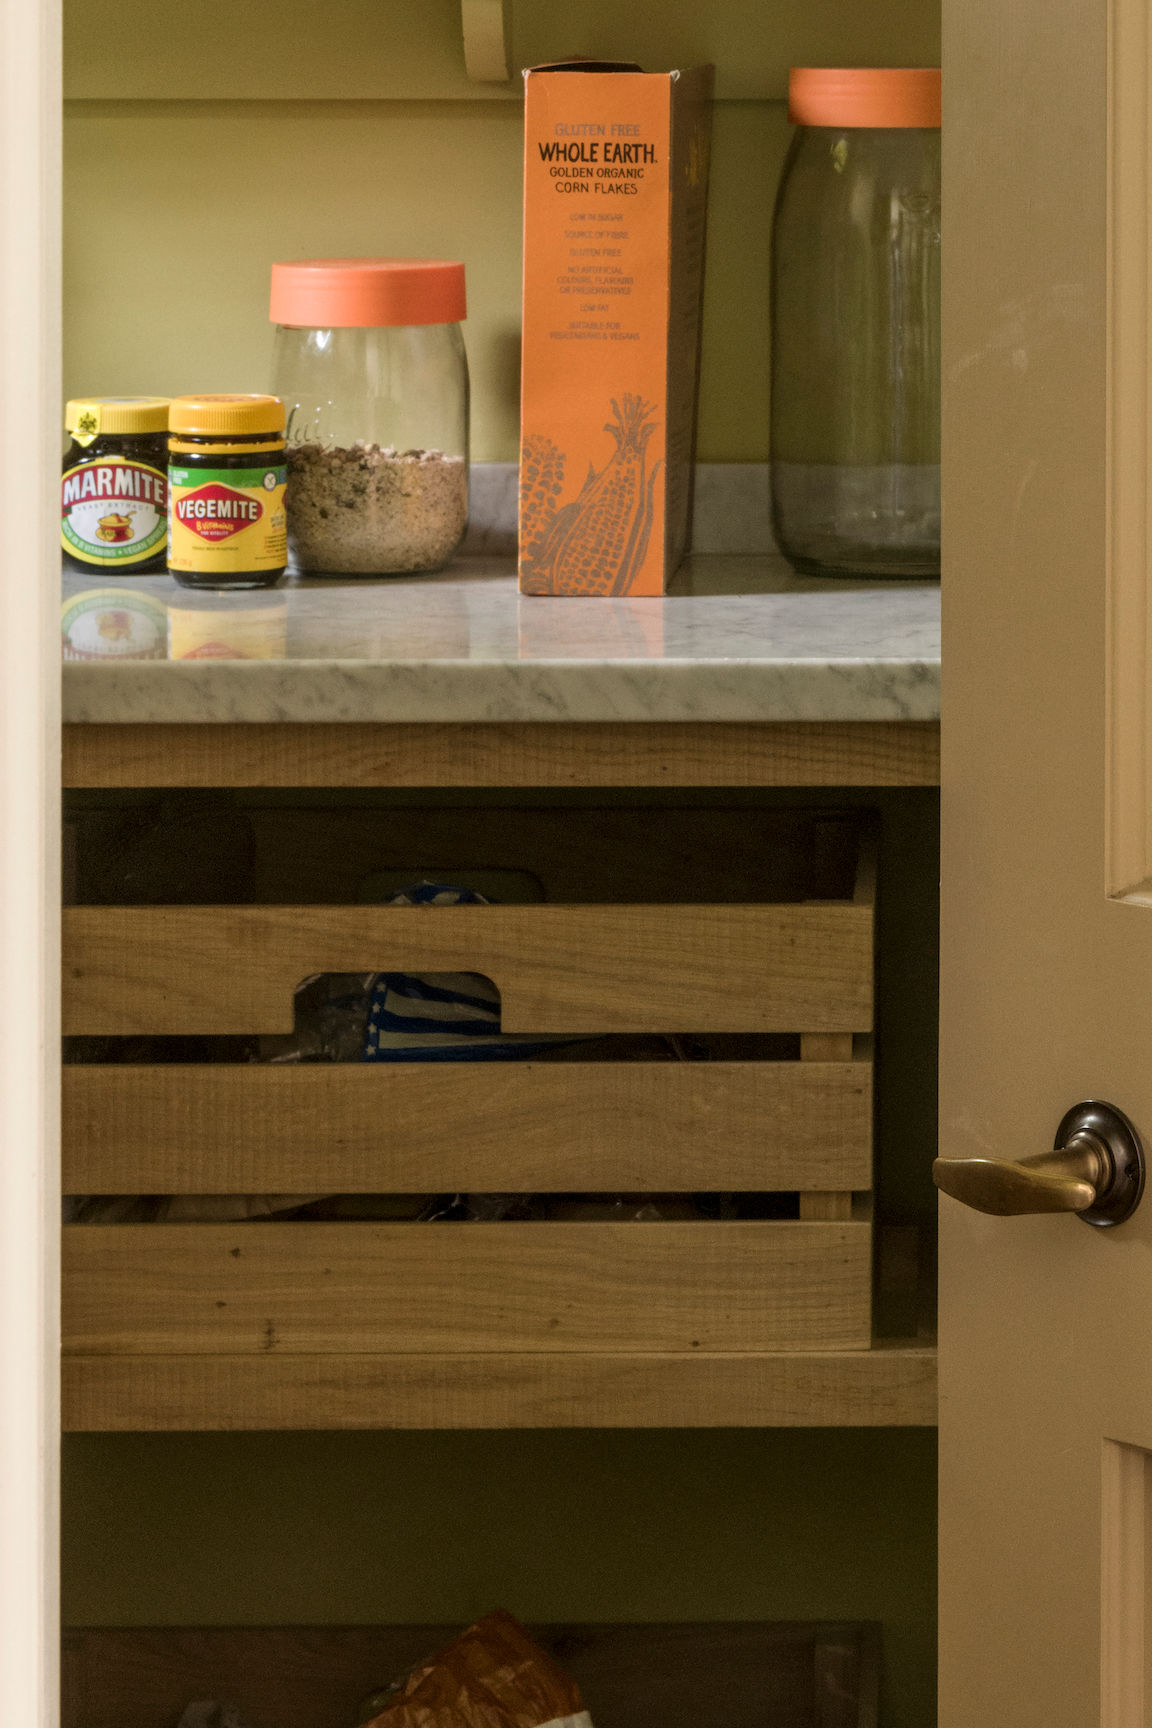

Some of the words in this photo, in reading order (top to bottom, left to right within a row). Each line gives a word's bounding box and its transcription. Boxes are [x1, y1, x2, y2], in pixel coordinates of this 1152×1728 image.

[554, 122, 606, 137] GLUTEN
[610, 123, 641, 137] FREE
[538, 142, 600, 163] WHOLE
[549, 166, 594, 179] GOLDEN
[596, 167, 645, 179] ORGANIC
[555, 181, 590, 194] CORN
[594, 183, 639, 195] FLAKES
[569, 248, 601, 257] GLUTEN
[602, 249, 622, 257] FREE
[63, 466, 164, 505] MARMITE
[177, 499, 258, 521] VEGEMITE
